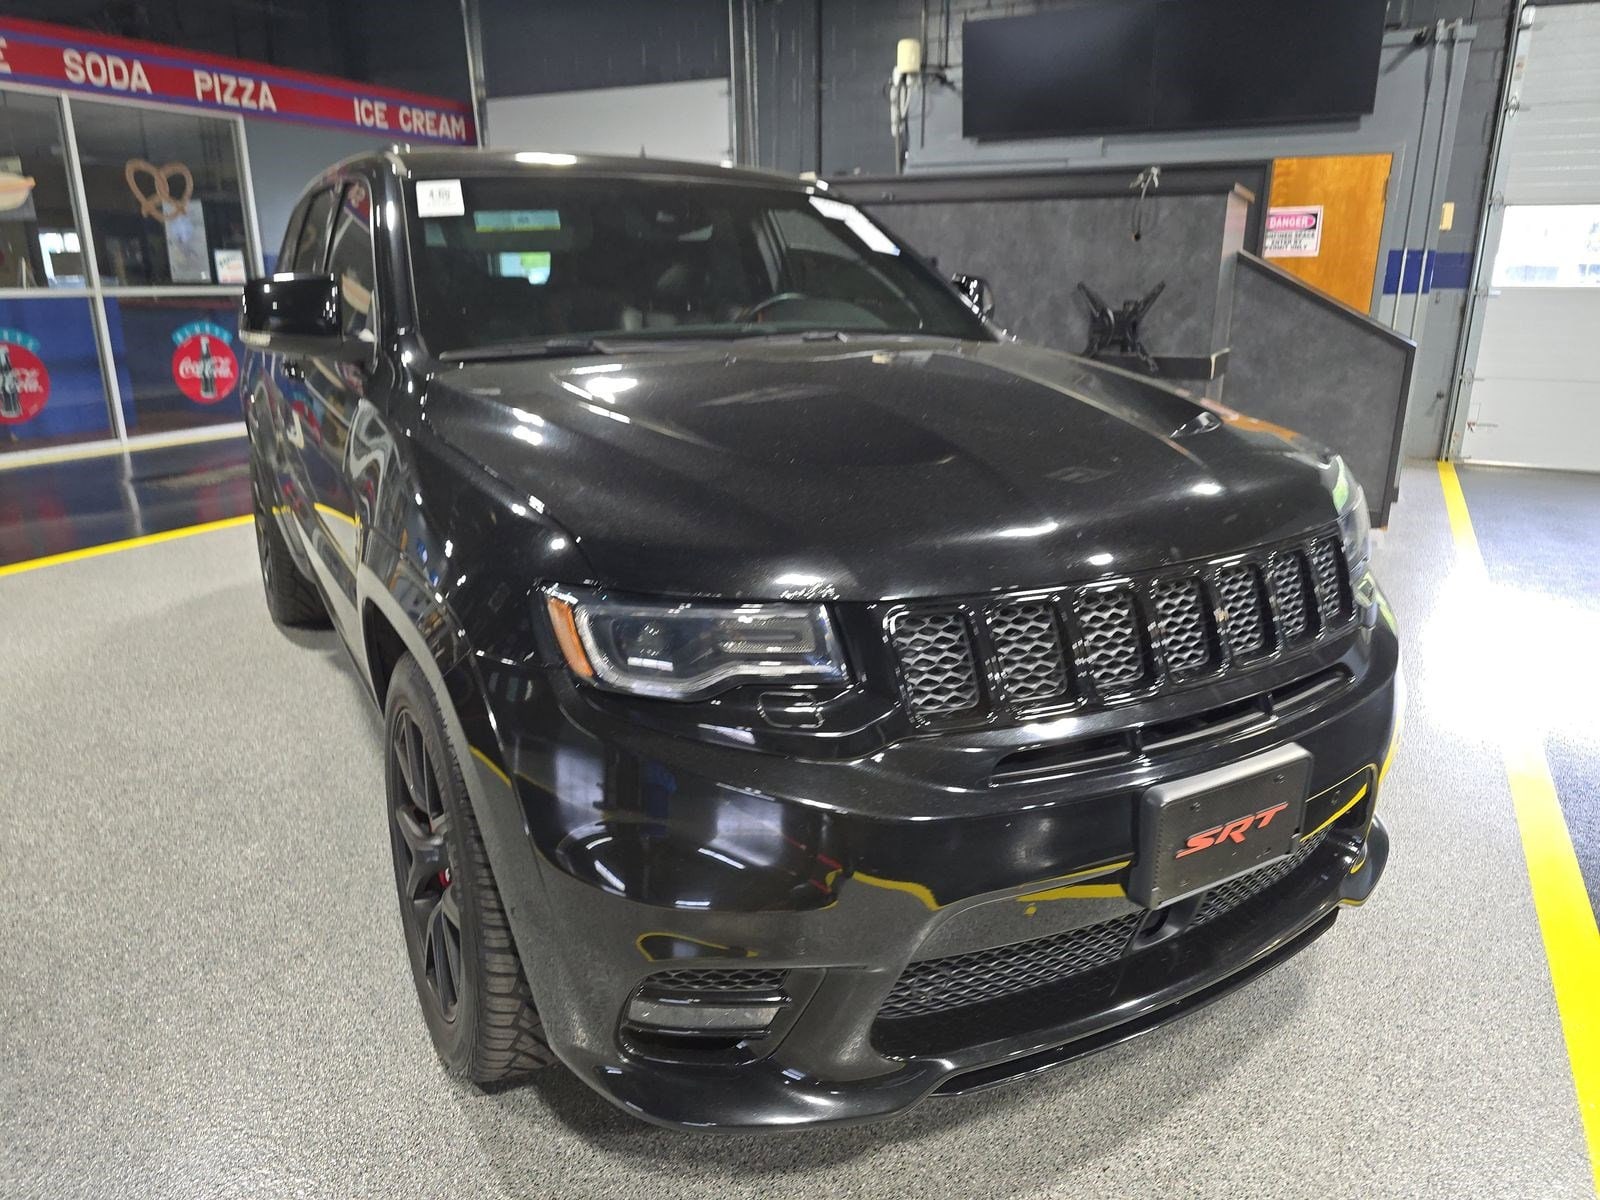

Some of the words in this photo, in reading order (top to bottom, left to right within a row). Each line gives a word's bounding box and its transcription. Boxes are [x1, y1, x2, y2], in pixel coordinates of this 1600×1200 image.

[62, 48, 153, 95] SODA
[193, 69, 278, 113] PIZZA
[353, 96, 389, 130] ICE
[399, 105, 466, 141] CREAM
[1269, 215, 1308, 229] DANGER
[1175, 801, 1289, 860] SRT
